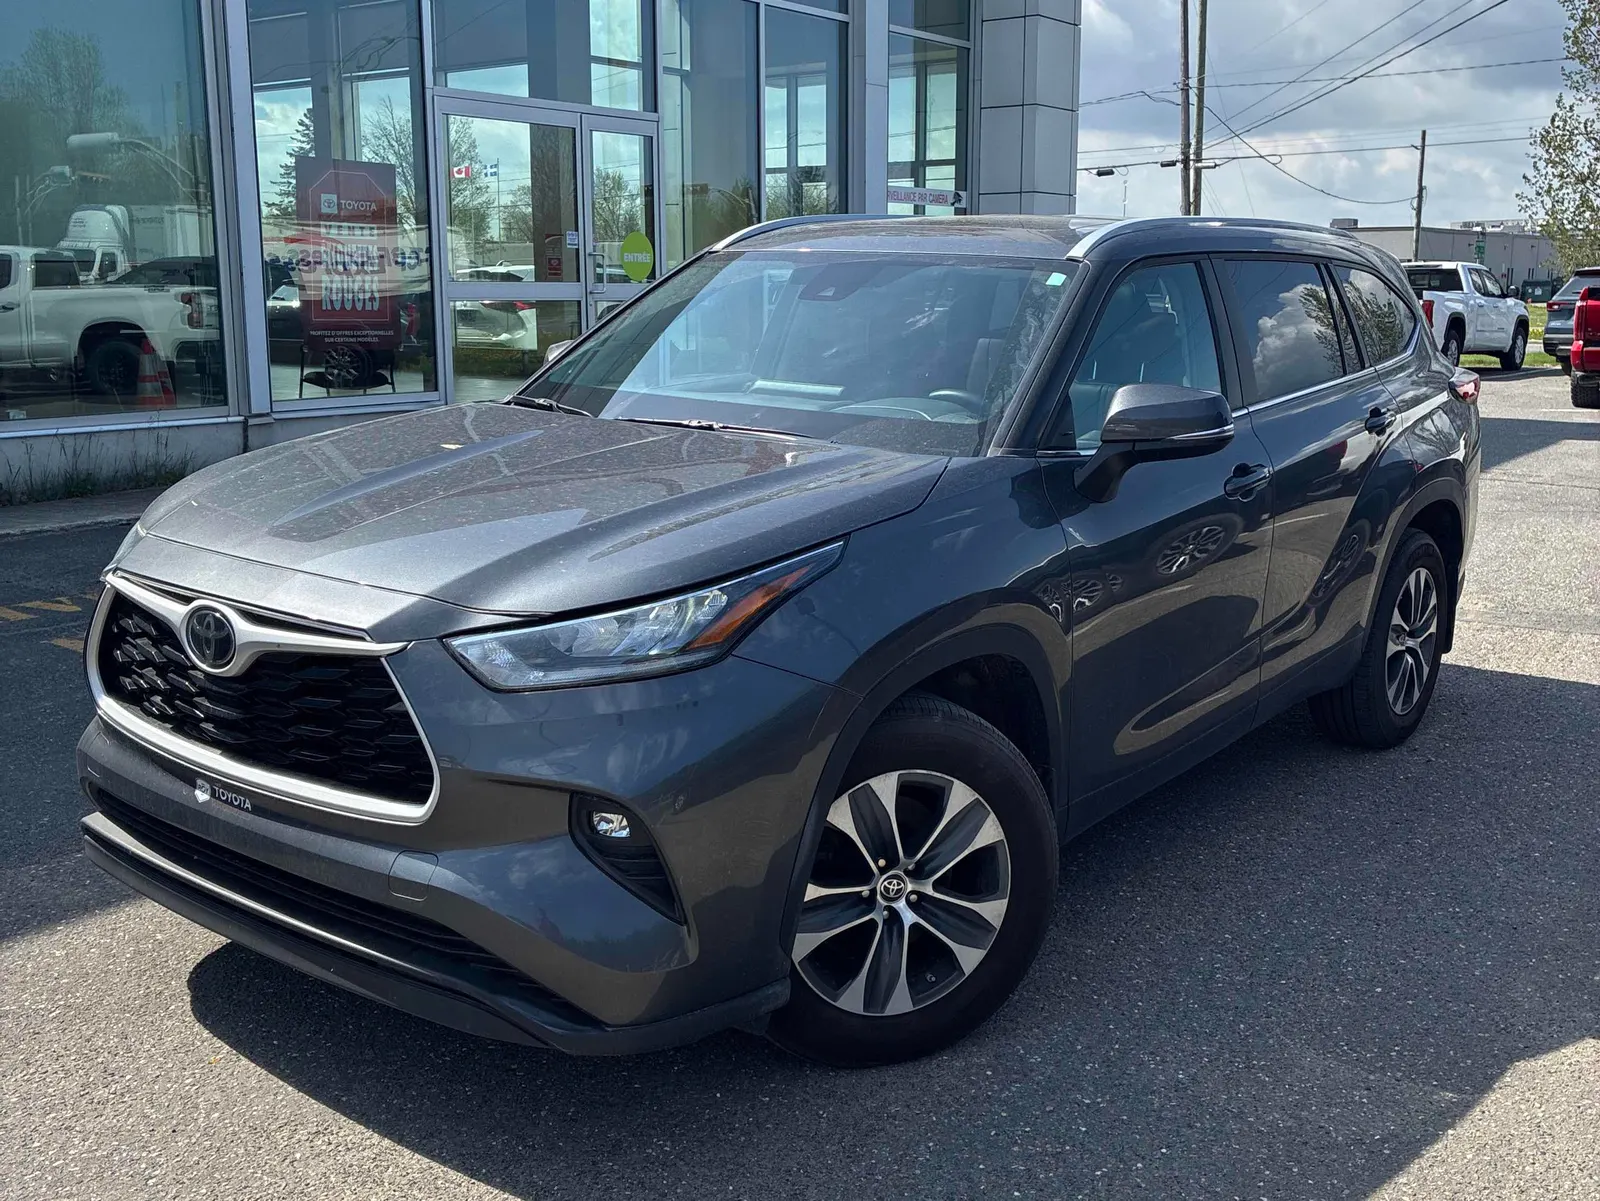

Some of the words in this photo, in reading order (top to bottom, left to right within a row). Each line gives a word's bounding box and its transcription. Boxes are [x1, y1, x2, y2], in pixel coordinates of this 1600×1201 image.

[917, 192, 928, 203] PAR
[340, 200, 378, 211] TOYOTA
[623, 251, 651, 263] ENTRÉE
[322, 275, 380, 311] ROUGES
[213, 785, 252, 811] TOYOTA
